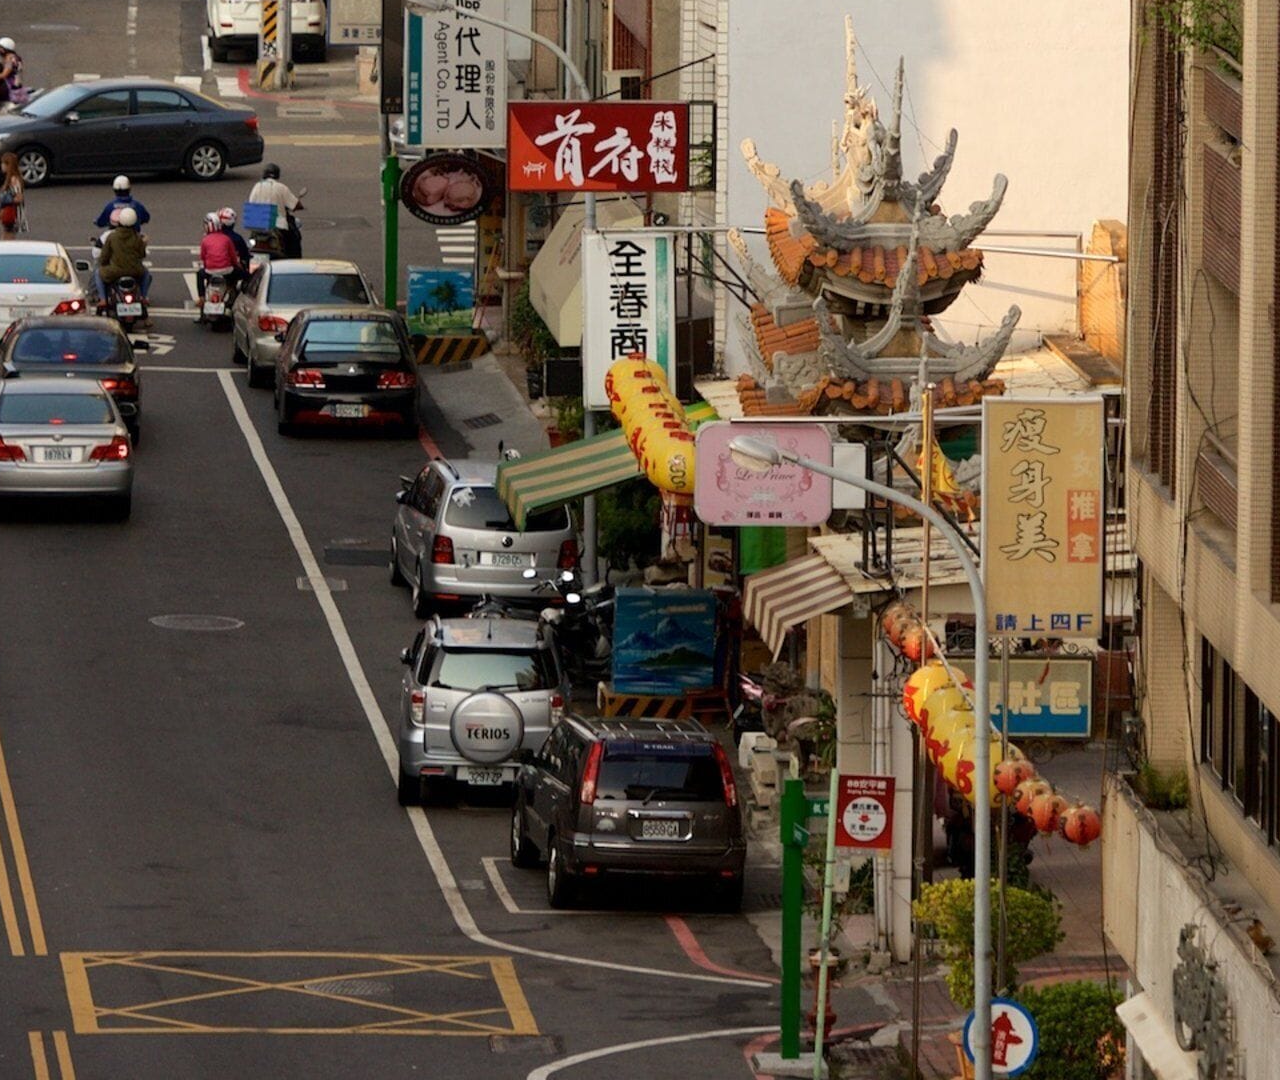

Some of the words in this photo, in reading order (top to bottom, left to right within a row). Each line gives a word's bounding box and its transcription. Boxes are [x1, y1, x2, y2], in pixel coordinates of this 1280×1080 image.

[434, 20, 450, 65] Agent
[484, 60, 496, 131] 股份有限公司
[999, 407, 1061, 563] 瘦身美
[995, 613, 1093, 632] 請上四F
[465, 727, 510, 740] TERIOS
